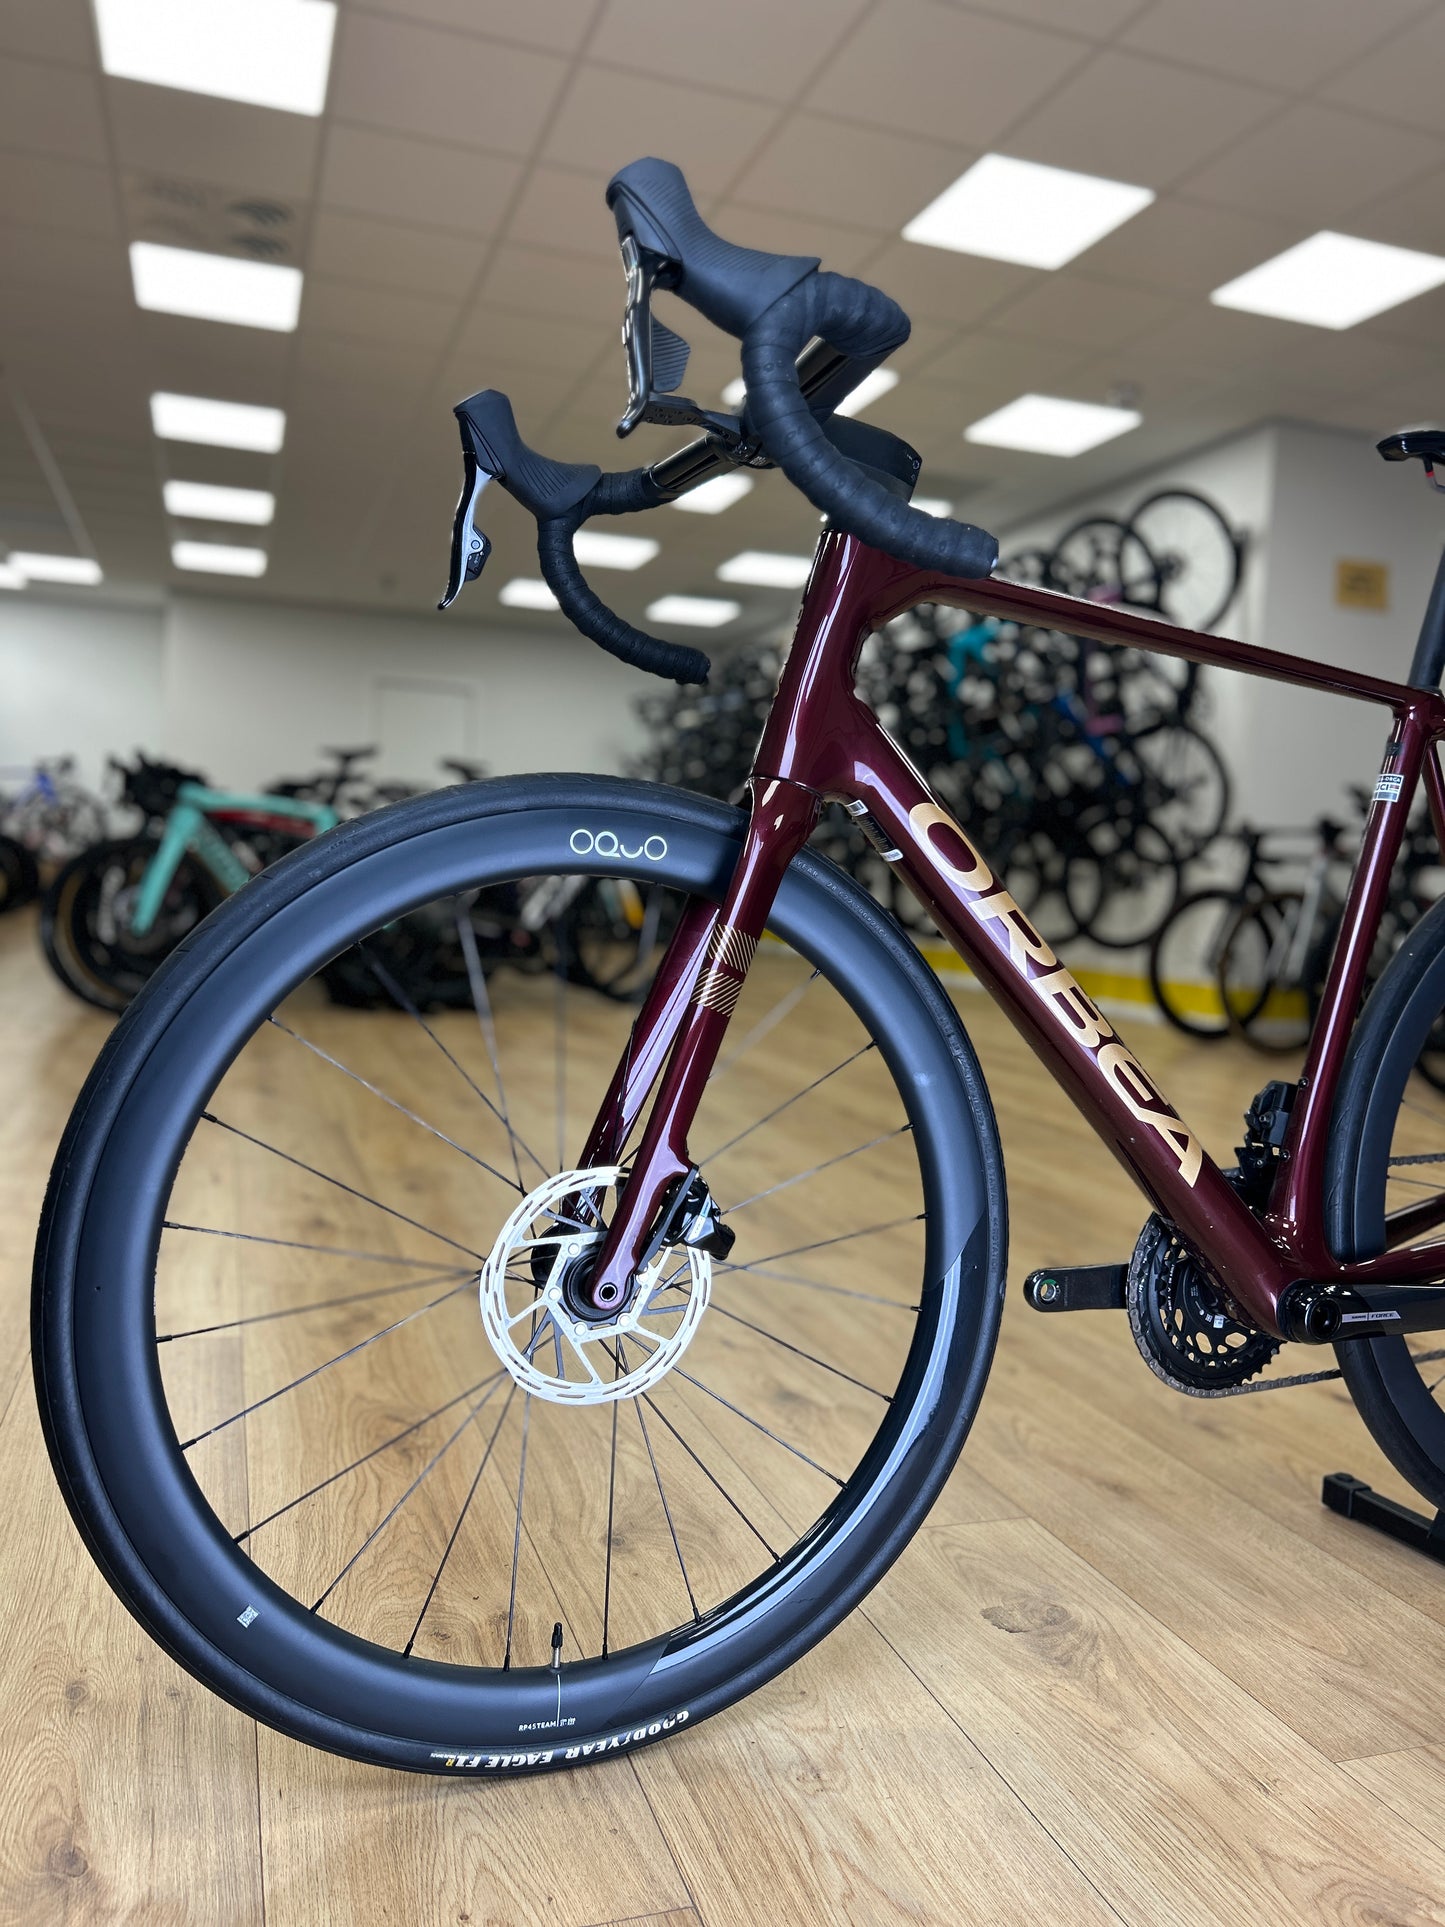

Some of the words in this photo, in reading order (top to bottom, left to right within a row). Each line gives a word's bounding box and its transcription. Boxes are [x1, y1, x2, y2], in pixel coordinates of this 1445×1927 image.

[570, 829, 668, 861] OQUO
[909, 802, 1202, 1188] ORBEA
[565, 1710, 689, 1759] GOODYEAR
[455, 1755, 482, 1768] F1
[484, 1750, 554, 1768] EAGLE
